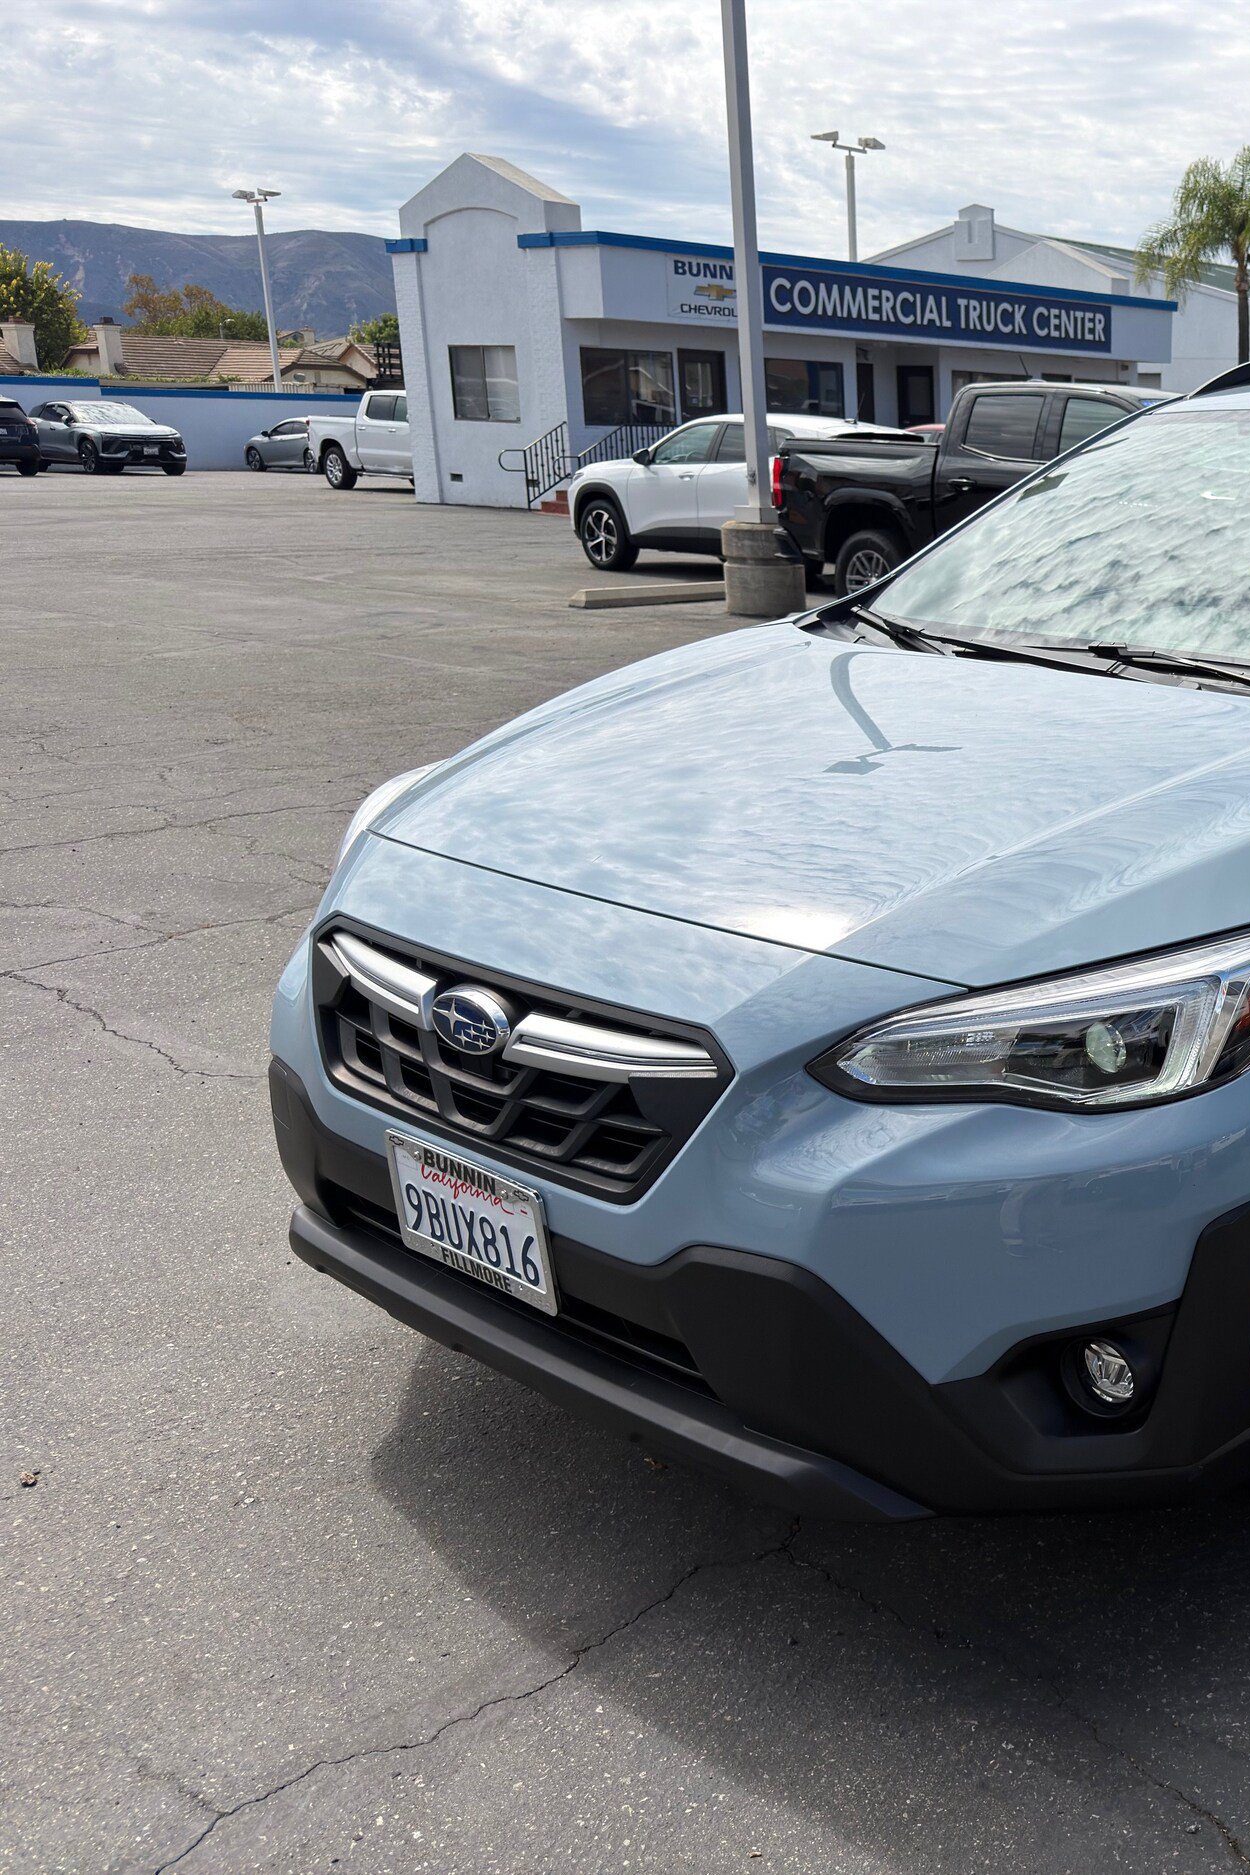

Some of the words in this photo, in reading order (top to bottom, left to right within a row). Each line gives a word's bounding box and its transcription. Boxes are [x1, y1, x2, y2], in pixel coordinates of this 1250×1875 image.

[673, 259, 733, 281] BUNN
[680, 303, 738, 318] CHEVROL
[770, 277, 952, 328] COMMERCIAL
[957, 298, 1028, 335] TRUCK
[1033, 306, 1105, 342] CENTER
[421, 1164, 515, 1216] California
[423, 1147, 497, 1196] BUNNIN
[405, 1183, 540, 1287] 9BUX816
[440, 1247, 513, 1294] FILLMORE
